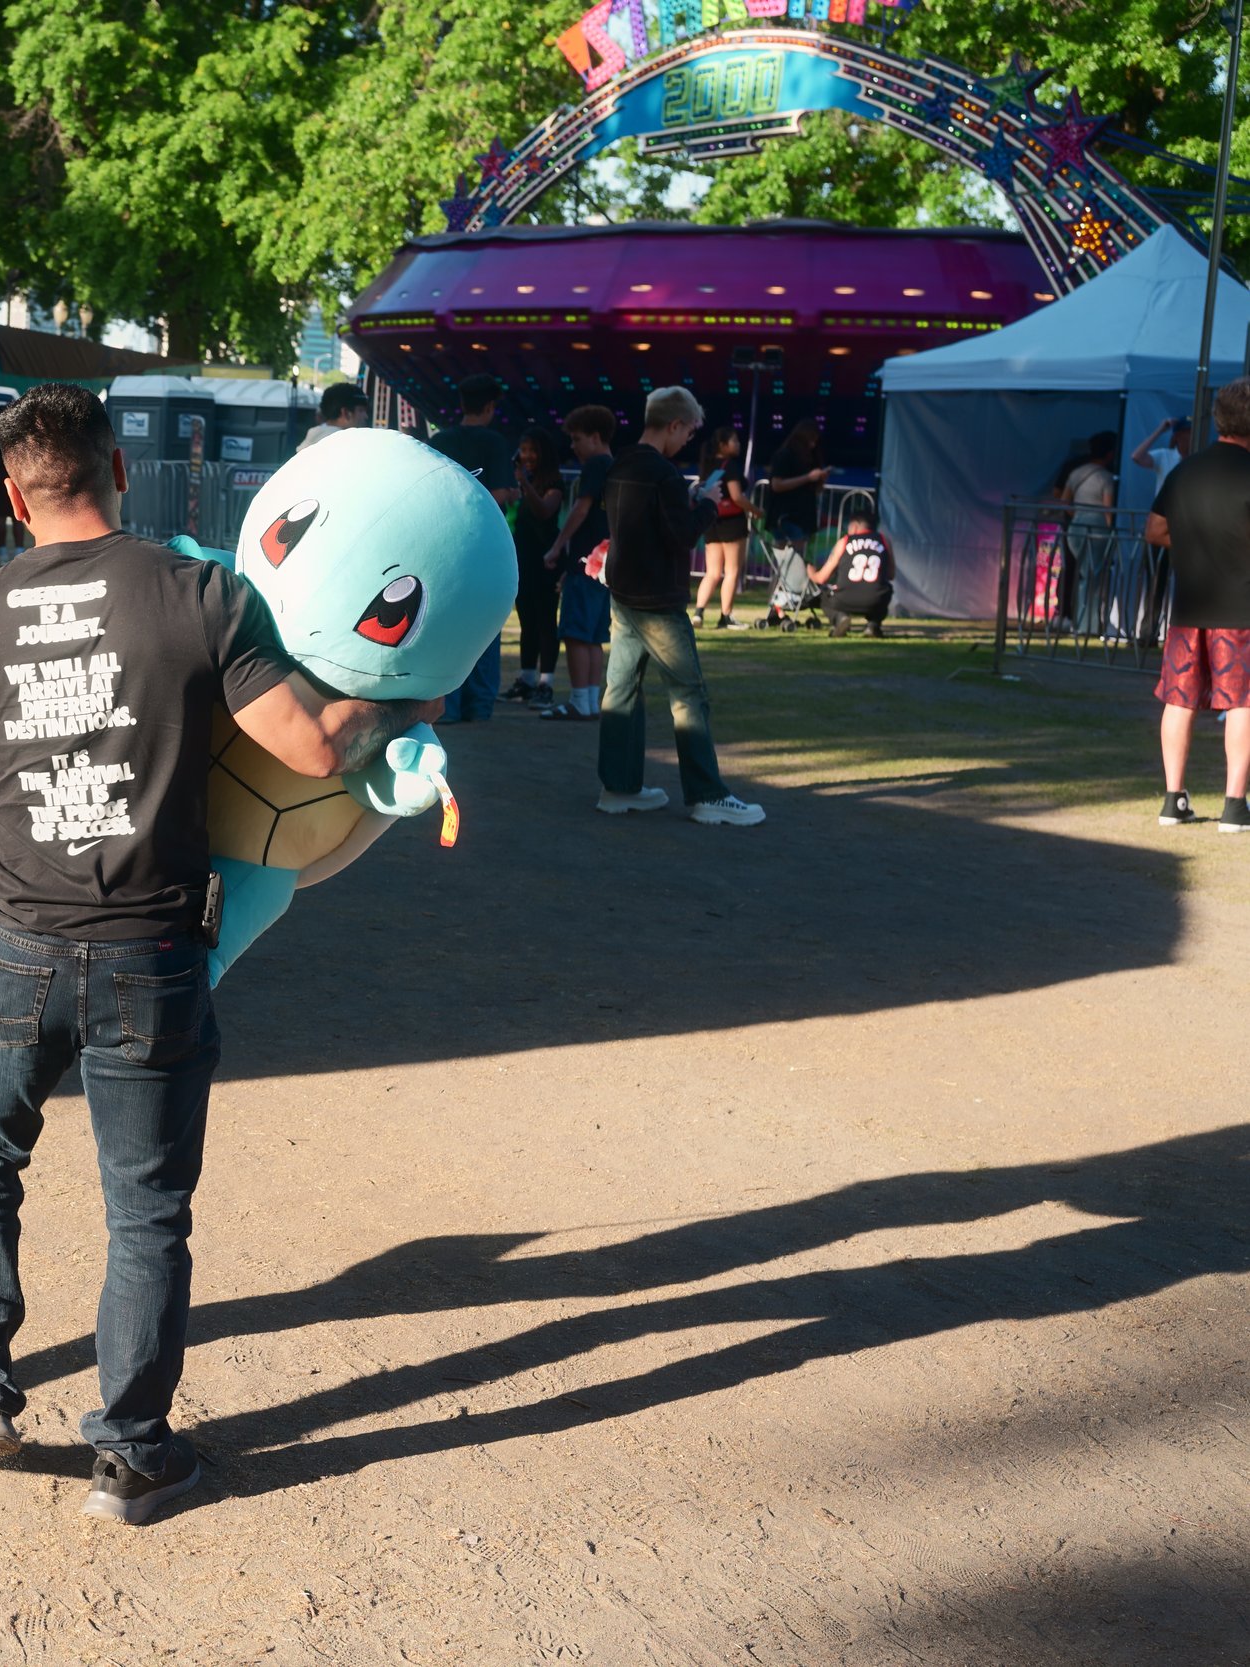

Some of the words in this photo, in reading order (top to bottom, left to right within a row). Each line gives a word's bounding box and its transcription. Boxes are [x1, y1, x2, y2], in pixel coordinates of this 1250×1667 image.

[662, 50, 784, 128] 2000
[848, 553, 881, 582] 33
[39, 604, 59, 625] IS
[60, 603, 77, 623] A
[16, 617, 106, 646] JOURNEY.
[4, 663, 38, 685] WE
[39, 657, 87, 680] WILL
[88, 652, 122, 675] ALL
[18, 676, 88, 702] ARRIVE
[90, 673, 114, 694] AT
[21, 691, 114, 721] DIFFERENT
[4, 706, 138, 740] DESTINATIONS.
[51, 754, 69, 770] IT
[73, 749, 91, 767] IS
[18, 772, 53, 791] THE
[56, 762, 136, 788] ARRIVAL
[41, 784, 88, 807] THAT
[91, 784, 110, 804] IS
[28, 806, 64, 823] THE
[64, 798, 128, 822] PROOF
[31, 822, 57, 842] OF
[58, 815, 136, 841] SUCCESS.
